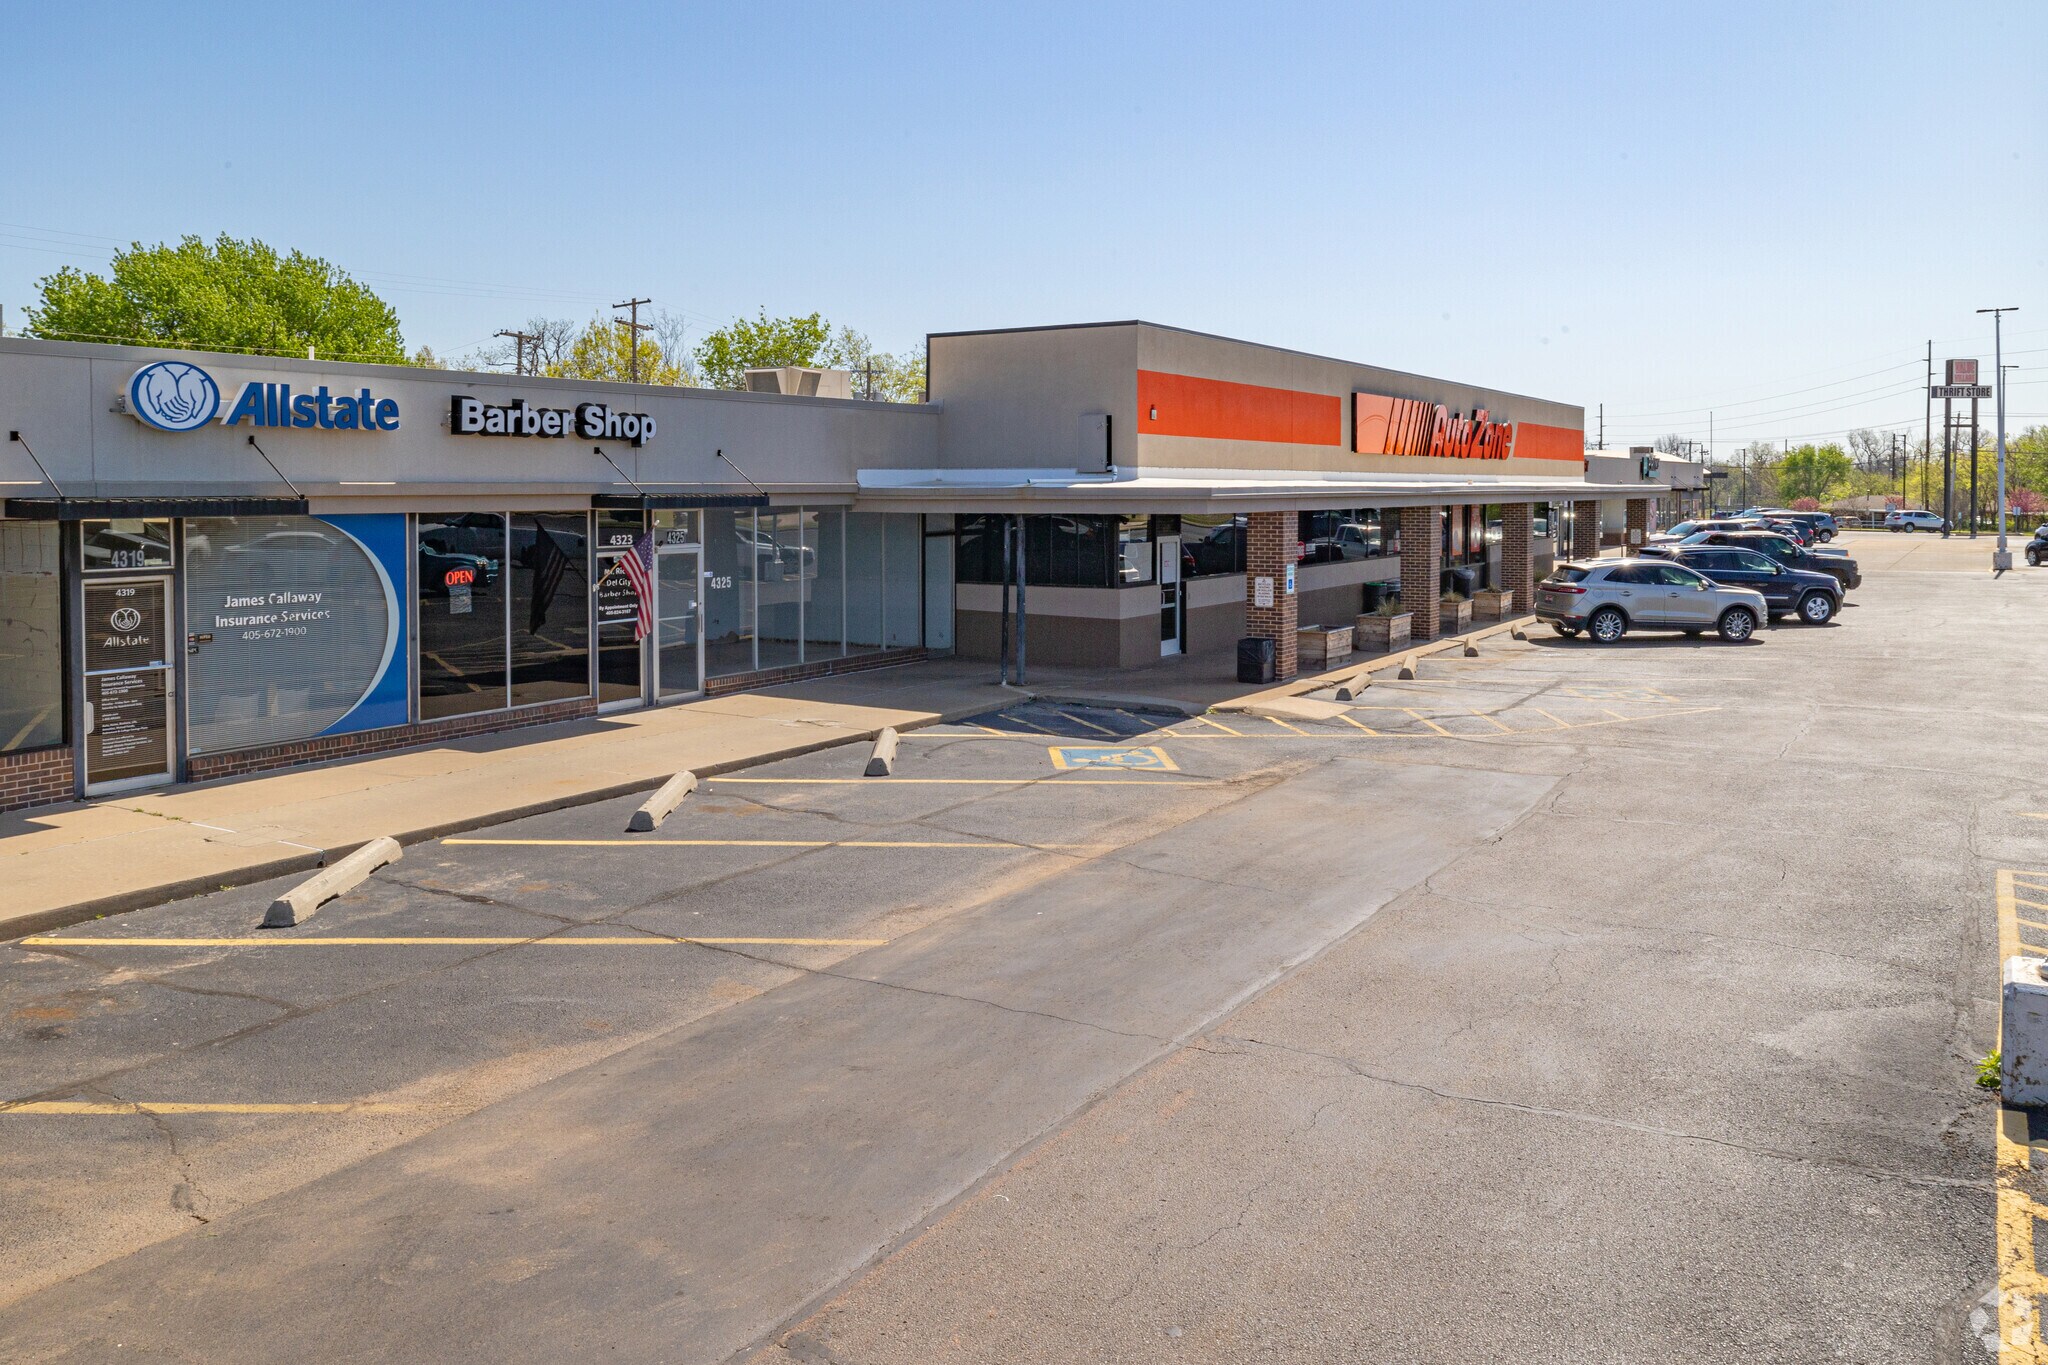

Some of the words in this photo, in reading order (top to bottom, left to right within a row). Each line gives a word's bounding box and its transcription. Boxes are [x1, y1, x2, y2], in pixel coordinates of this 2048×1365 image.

[1939, 387, 1965, 397] THRIFT
[1966, 387, 1990, 397] STORE
[222, 381, 400, 431] Allstate
[459, 398, 575, 436] Barber
[582, 405, 657, 445] Shop
[1429, 403, 1513, 460] AutoZone
[609, 534, 633, 546] 4323
[667, 531, 685, 544] 4325
[111, 550, 145, 567] 4319
[445, 569, 474, 585] OPEN
[606, 579, 618, 587] Del
[618, 578, 632, 587] City
[710, 576, 732, 589] 4325
[115, 588, 136, 597] 4319
[224, 595, 265, 608] James
[268, 591, 322, 605] Callaway
[599, 590, 621, 599] Barber
[215, 614, 278, 628] Insurance
[280, 609, 331, 623] Services
[241, 626, 307, 641] 405-672-1900
[103, 635, 150, 648] Allstate
